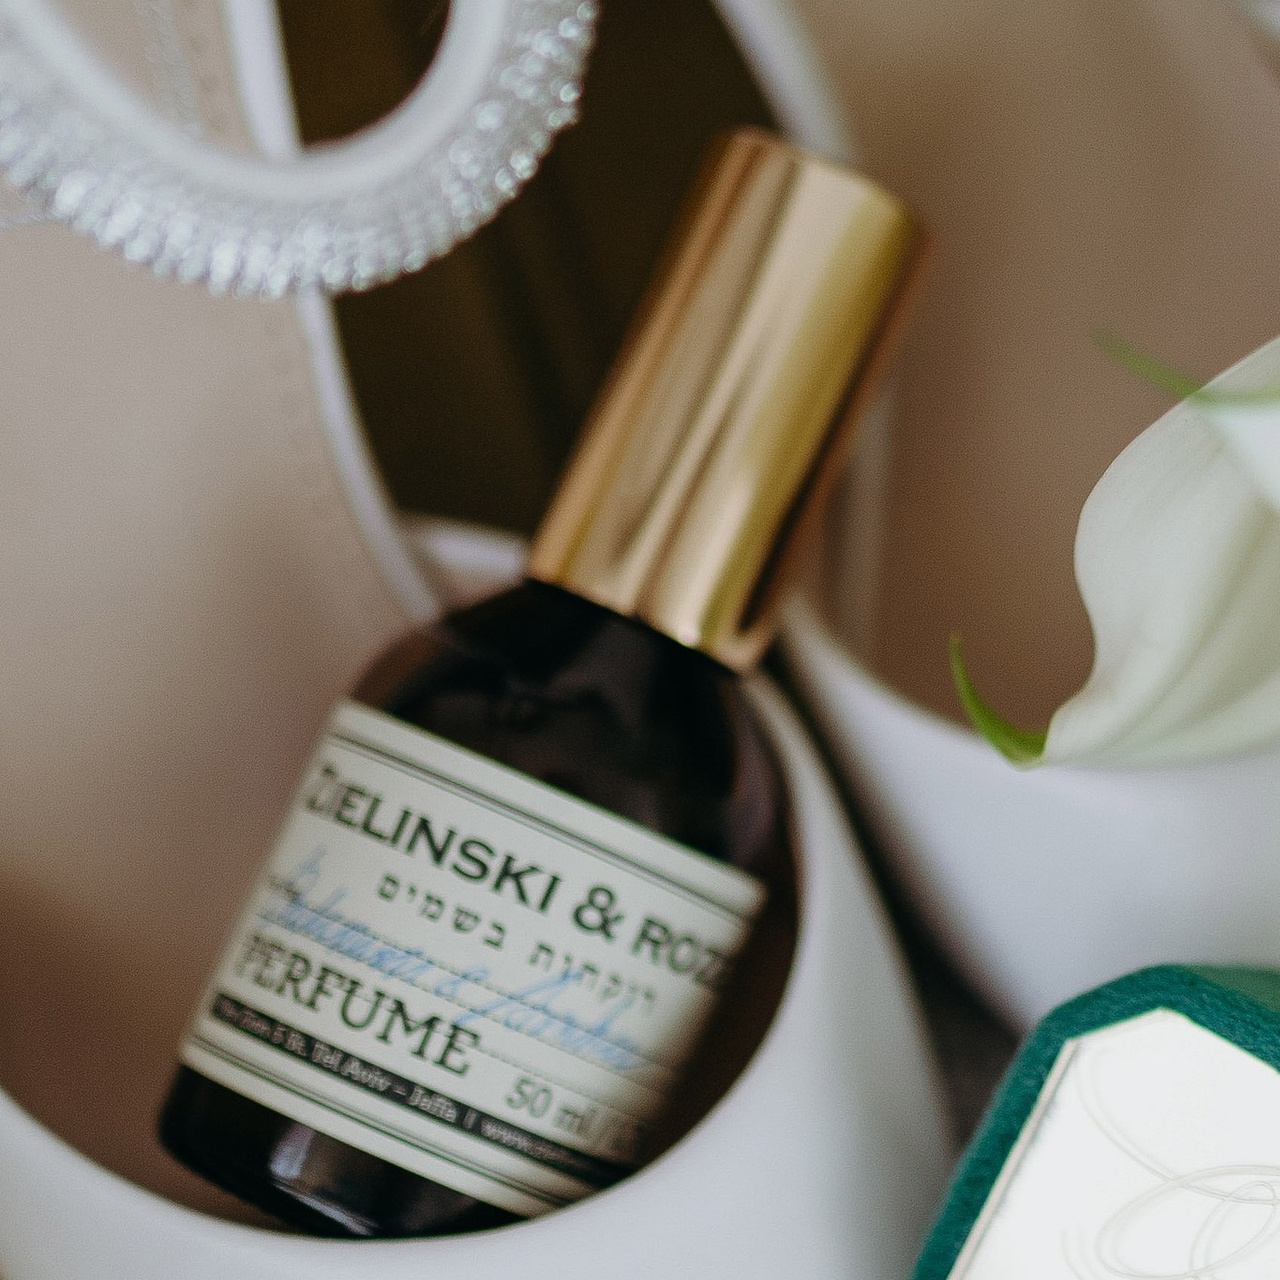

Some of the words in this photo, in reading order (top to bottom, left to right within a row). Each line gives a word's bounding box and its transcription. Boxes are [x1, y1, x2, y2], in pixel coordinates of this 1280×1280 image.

[376, 872, 512, 953] בשמים
[571, 883, 628, 941] &
[232, 933, 481, 1078] PERFUME
[309, 1042, 345, 1073] Tel
[338, 1055, 394, 1095] Aviv
[405, 1084, 460, 1124] Jaffa
[504, 1076, 554, 1121] 50
